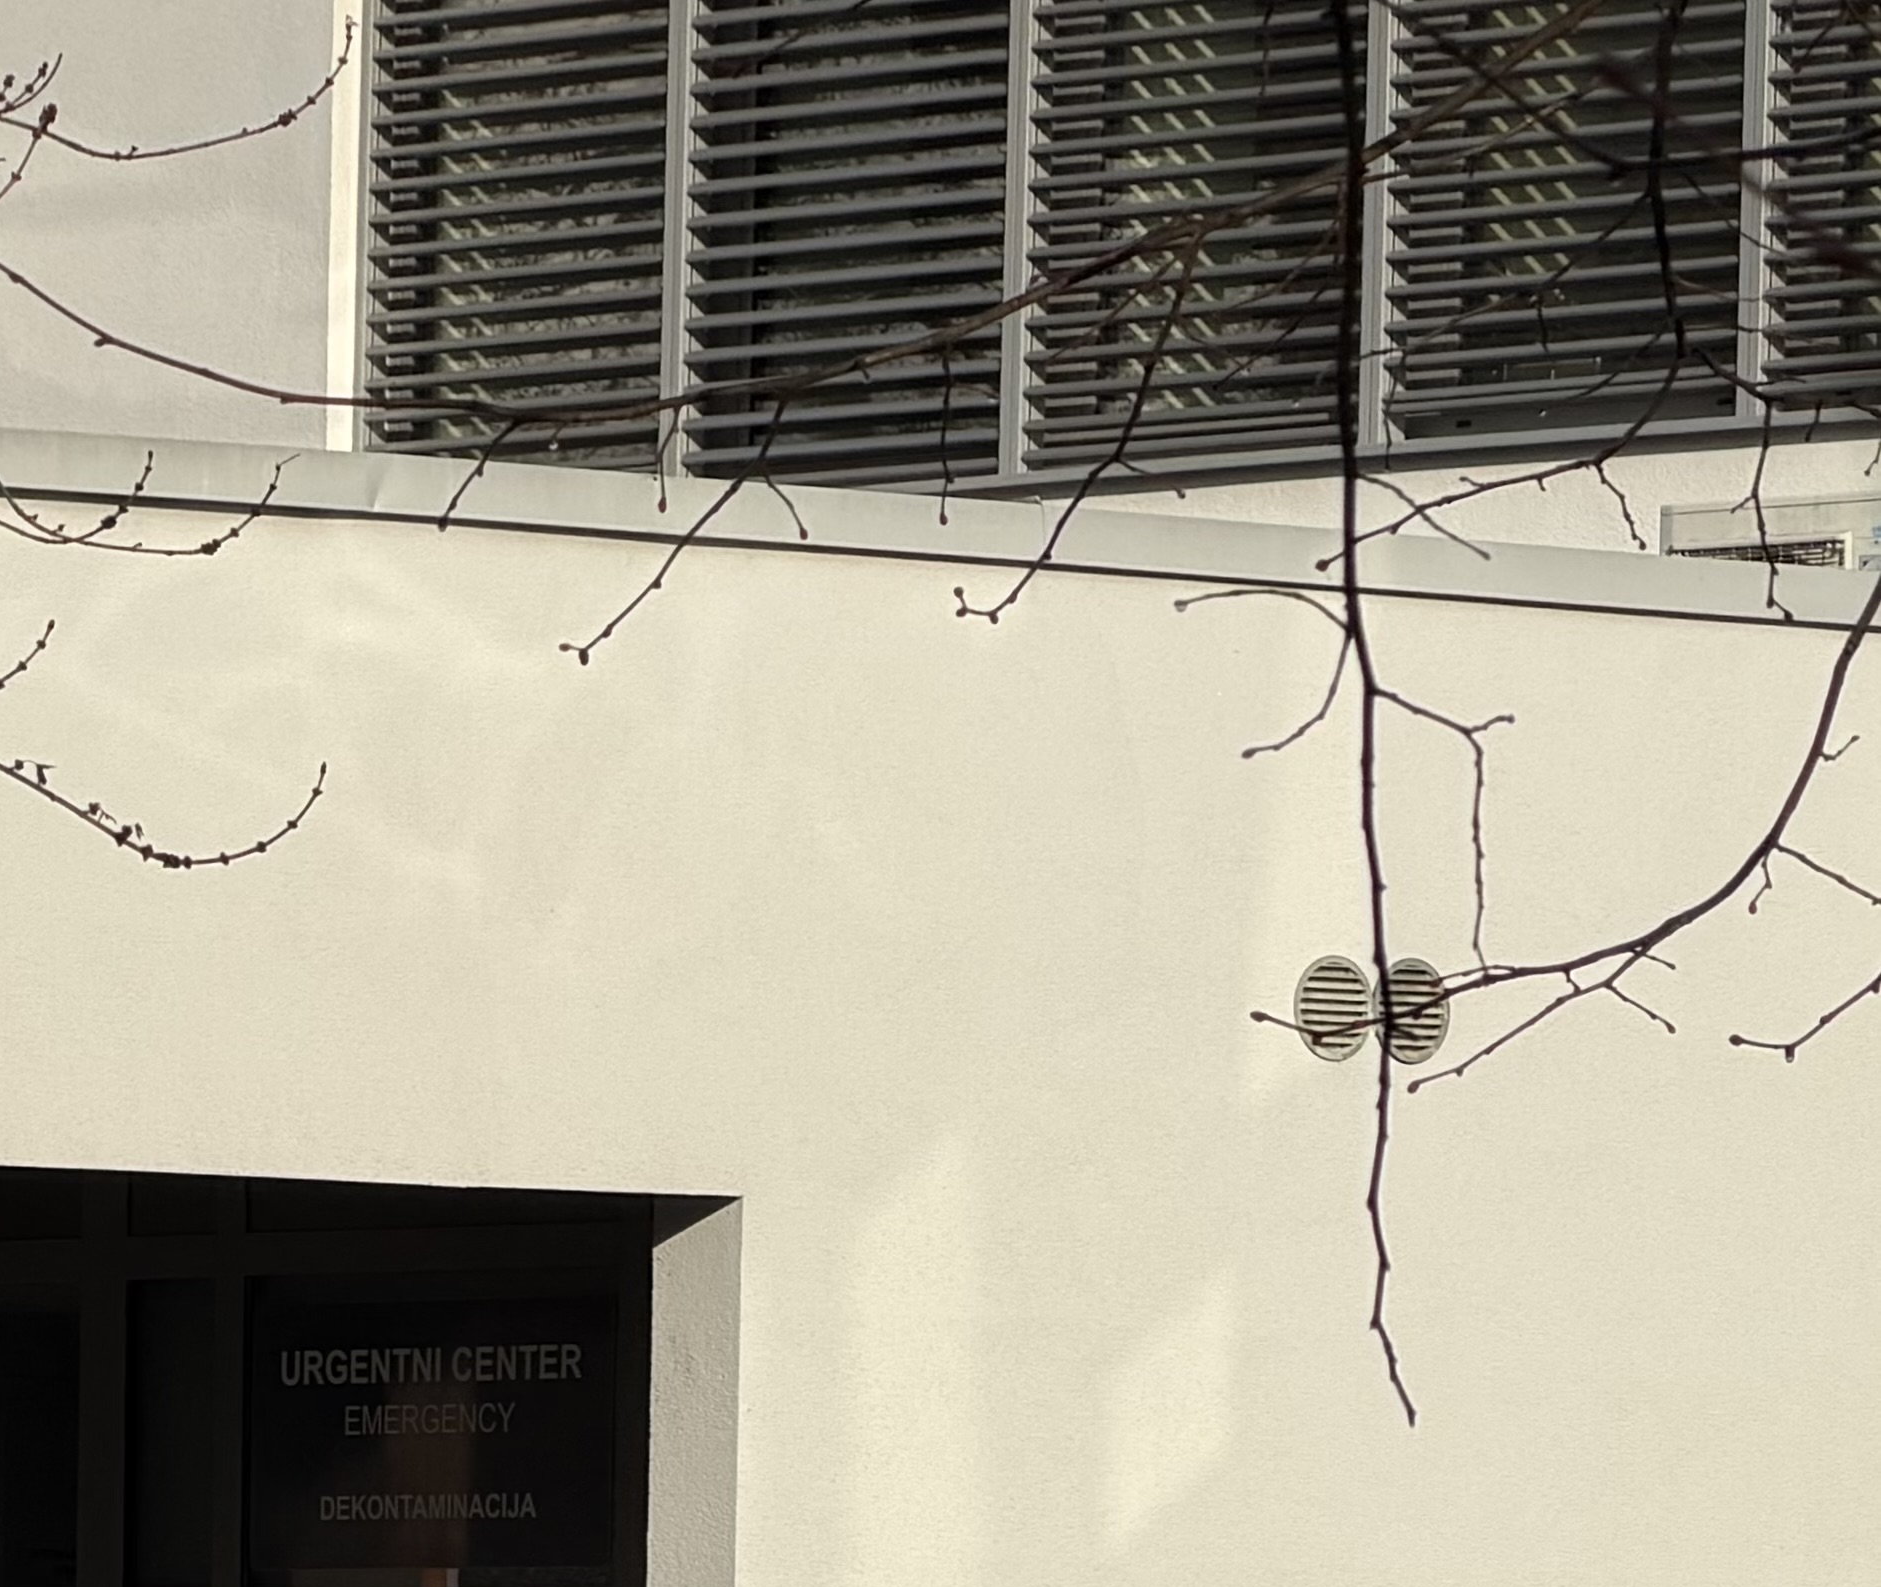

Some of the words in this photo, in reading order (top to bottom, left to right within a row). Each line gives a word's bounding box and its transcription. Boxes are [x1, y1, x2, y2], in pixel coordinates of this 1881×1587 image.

[281, 1347, 441, 1386] URGENTNI
[451, 1344, 582, 1382] CENTER
[344, 1402, 516, 1436] EMERGENCY
[320, 1493, 537, 1521] DEKONTAMINACIJA
